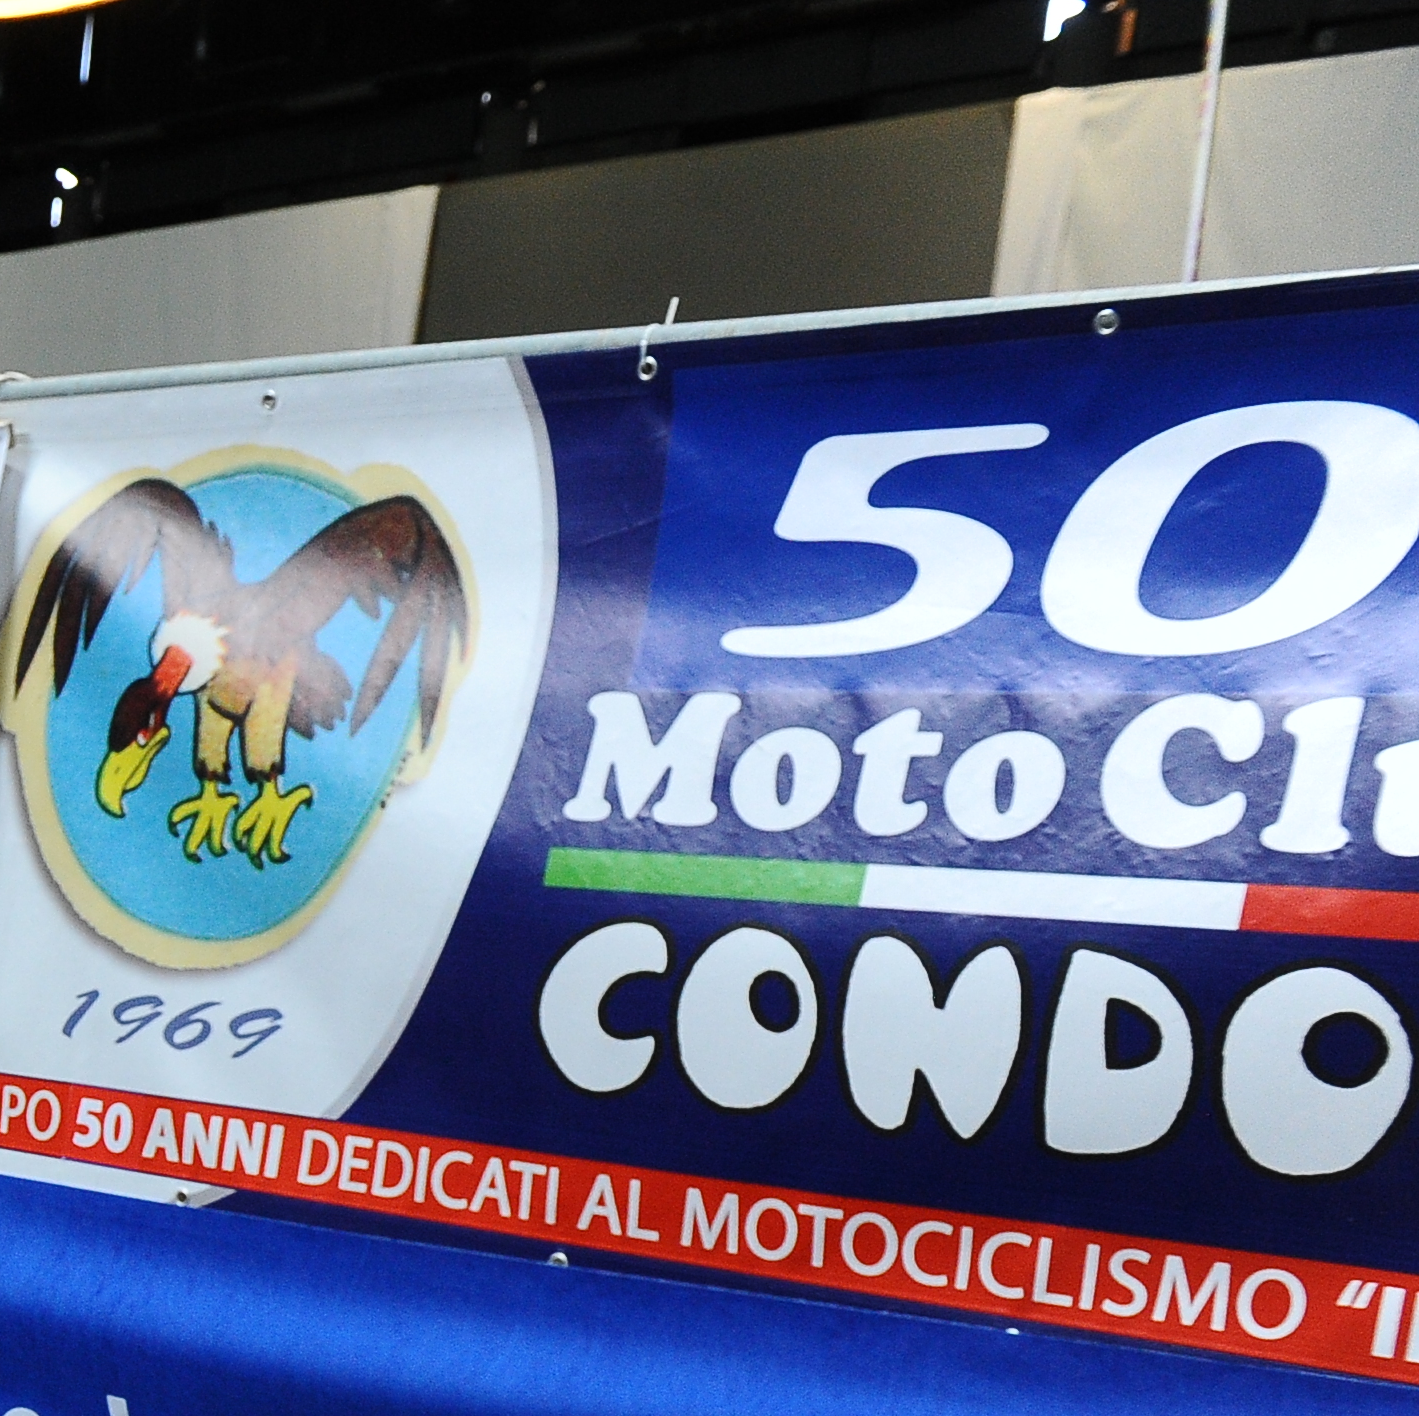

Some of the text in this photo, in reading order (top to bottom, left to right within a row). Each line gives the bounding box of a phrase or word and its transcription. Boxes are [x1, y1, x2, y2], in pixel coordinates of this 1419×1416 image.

[721, 400, 1419, 658] 50
[562, 691, 1066, 841] Moto
[62, 990, 284, 1058] 1969
[538, 920, 1416, 1177] CONDO
[72, 1098, 132, 1153] 50
[142, 1108, 284, 1178] ANNI
[298, 1129, 561, 1225] DEDICATI
[576, 1174, 660, 1242] AL
[680, 1187, 1307, 1340] MOTOCICLISMO
